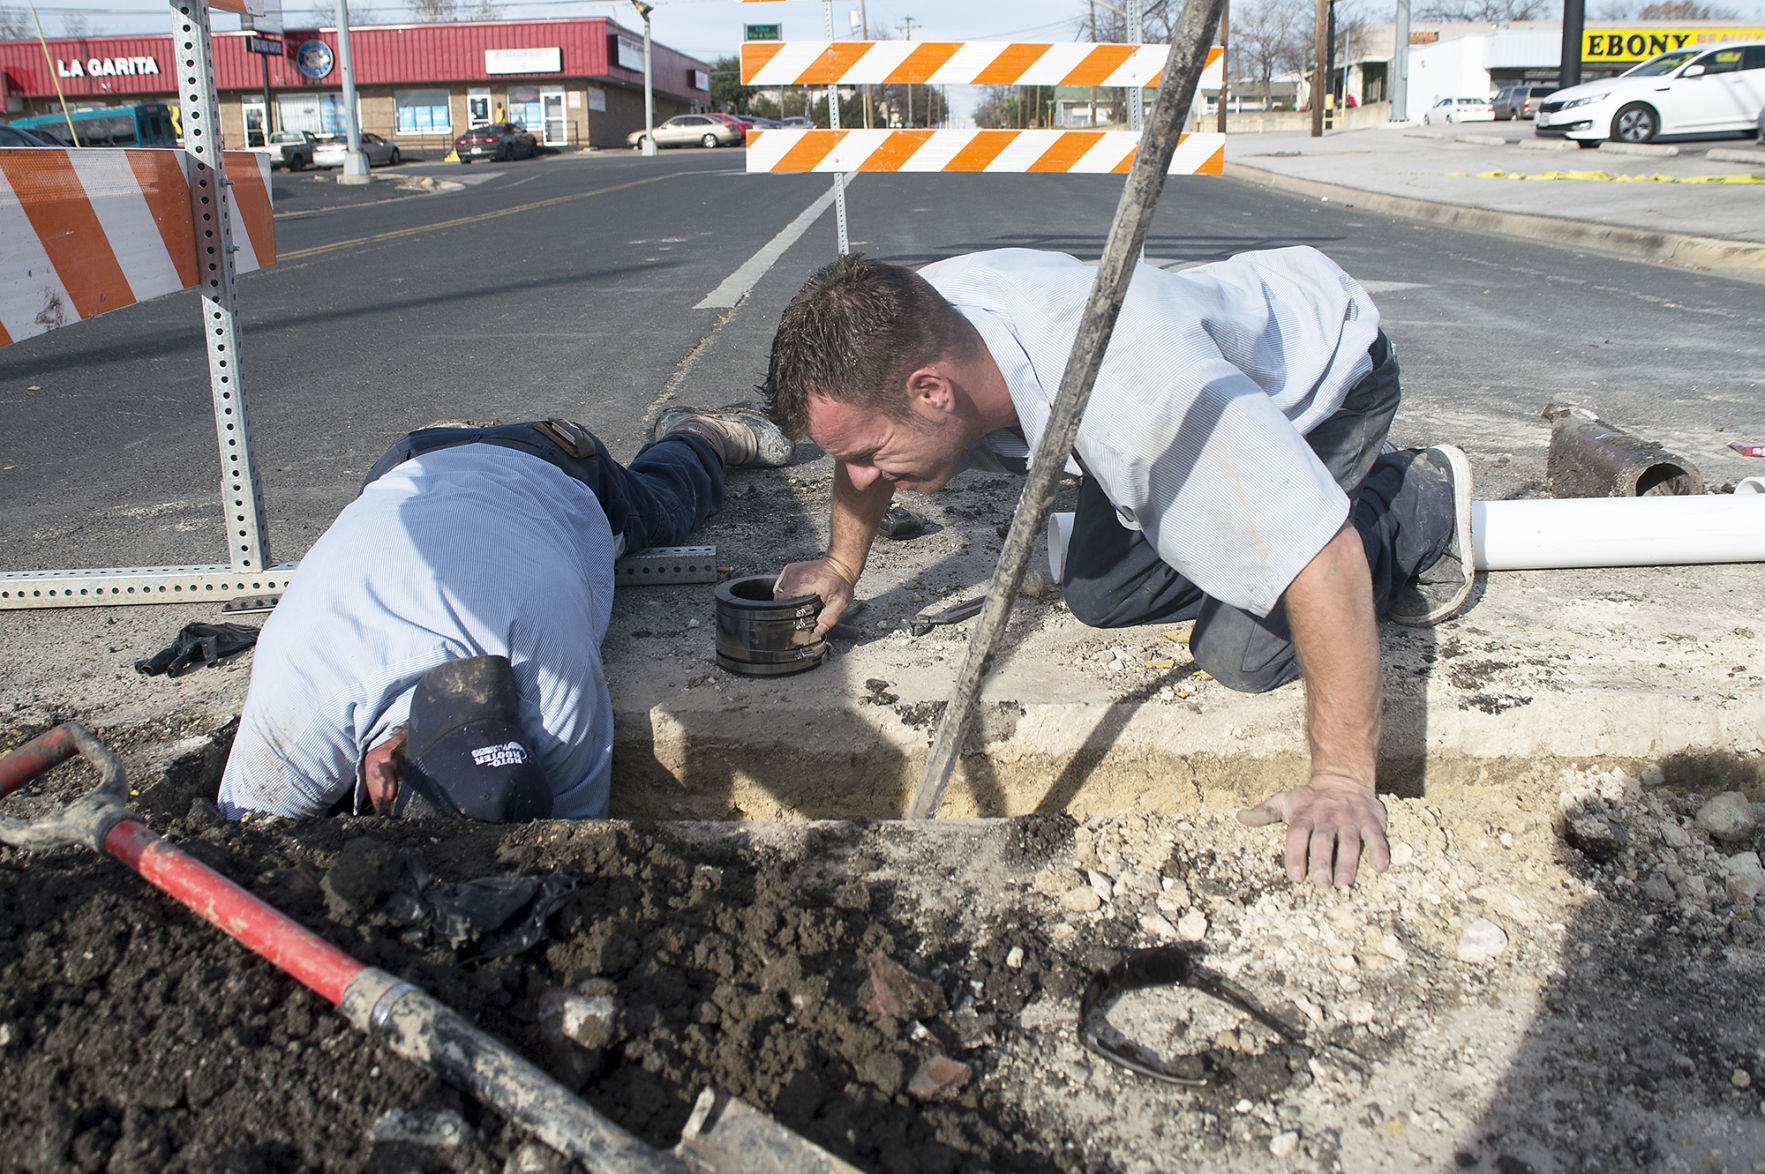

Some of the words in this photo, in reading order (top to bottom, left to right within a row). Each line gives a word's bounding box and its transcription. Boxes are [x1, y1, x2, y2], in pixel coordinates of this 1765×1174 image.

[1588, 34, 1690, 56] EBONY
[57, 59, 84, 77] LA
[87, 57, 160, 77] GARITA
[474, 750, 521, 765] ROOTER
[487, 757, 522, 767] ROTO-
